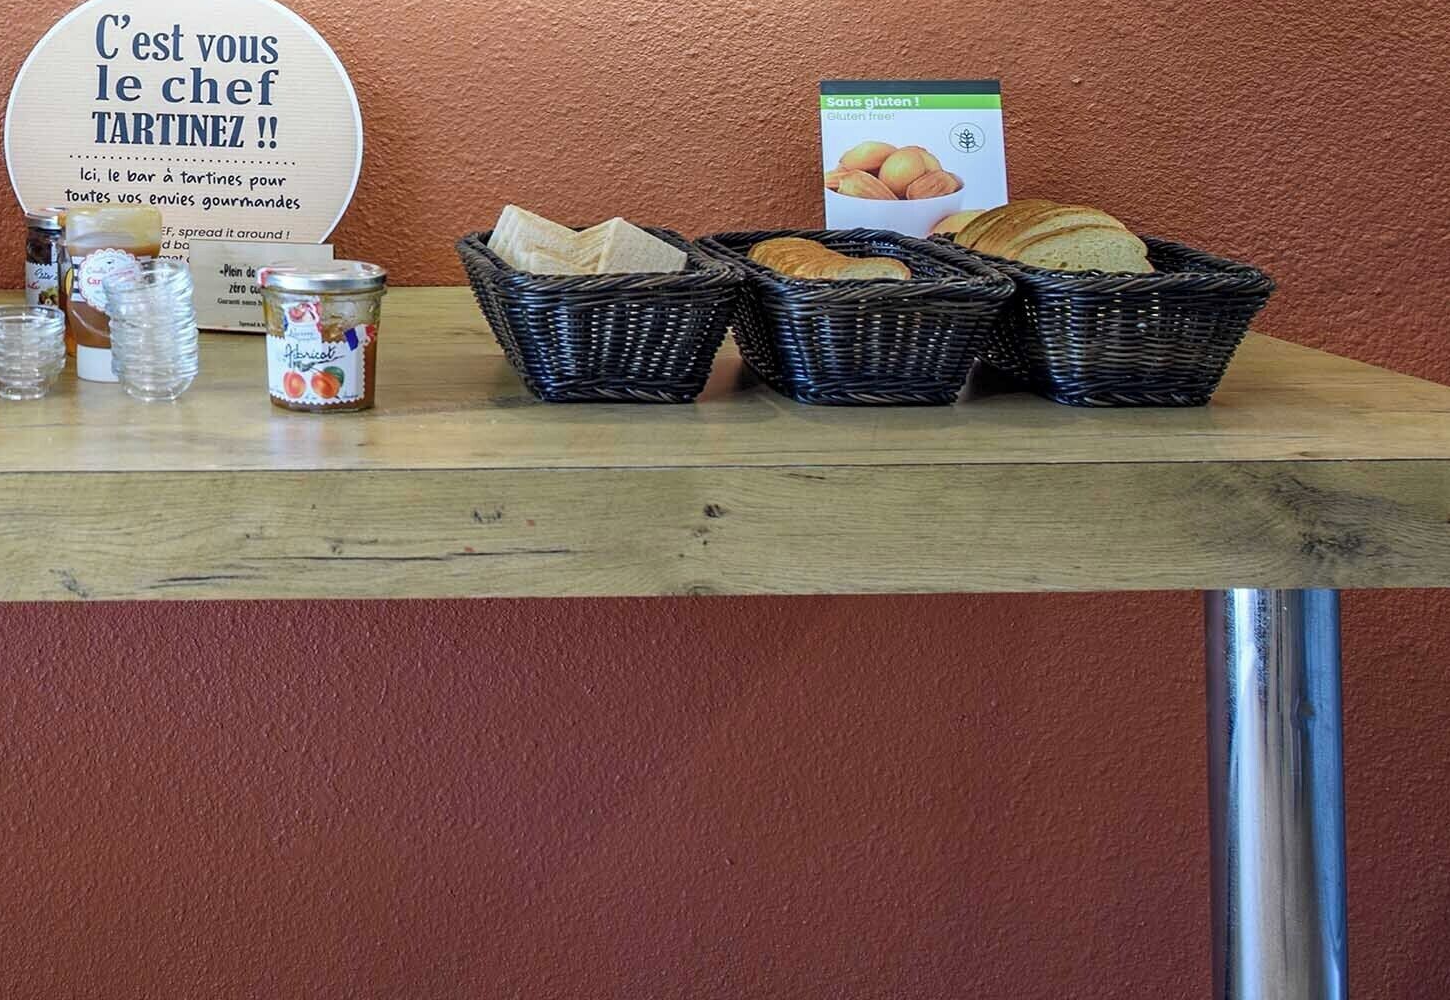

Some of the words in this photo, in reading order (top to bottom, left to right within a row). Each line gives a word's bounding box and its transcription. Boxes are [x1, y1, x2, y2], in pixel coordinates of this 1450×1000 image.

[95, 13, 185, 62] C’est
[196, 34, 280, 65] vous
[95, 64, 143, 102] le
[161, 67, 280, 106] chef
[827, 96, 863, 108] Sans
[864, 96, 912, 110] gluten
[914, 96, 920, 107] !
[827, 111, 867, 121] Gluten
[869, 111, 895, 121] free!
[92, 111, 246, 149] TARTINEZ
[257, 116, 279, 150] !!
[80, 167, 101, 183] Ici,
[108, 168, 120, 183] le
[127, 170, 156, 183] bar
[163, 167, 174, 183] à
[180, 170, 243, 187] tartines
[249, 175, 287, 192] pour
[65, 188, 111, 204] toutes
[118, 193, 143, 204] vos
[150, 192, 196, 207] envies
[202, 194, 301, 211] gourmandes
[161, 226, 175, 238] EF,
[178, 228, 223, 239] spread
[226, 228, 234, 238] it
[237, 230, 283, 240] around
[285, 231, 291, 240] !
[161, 240, 171, 249] d
[174, 240, 190, 250] ba
[86, 276, 103, 286] Car
[284, 343, 338, 367] Abricot
